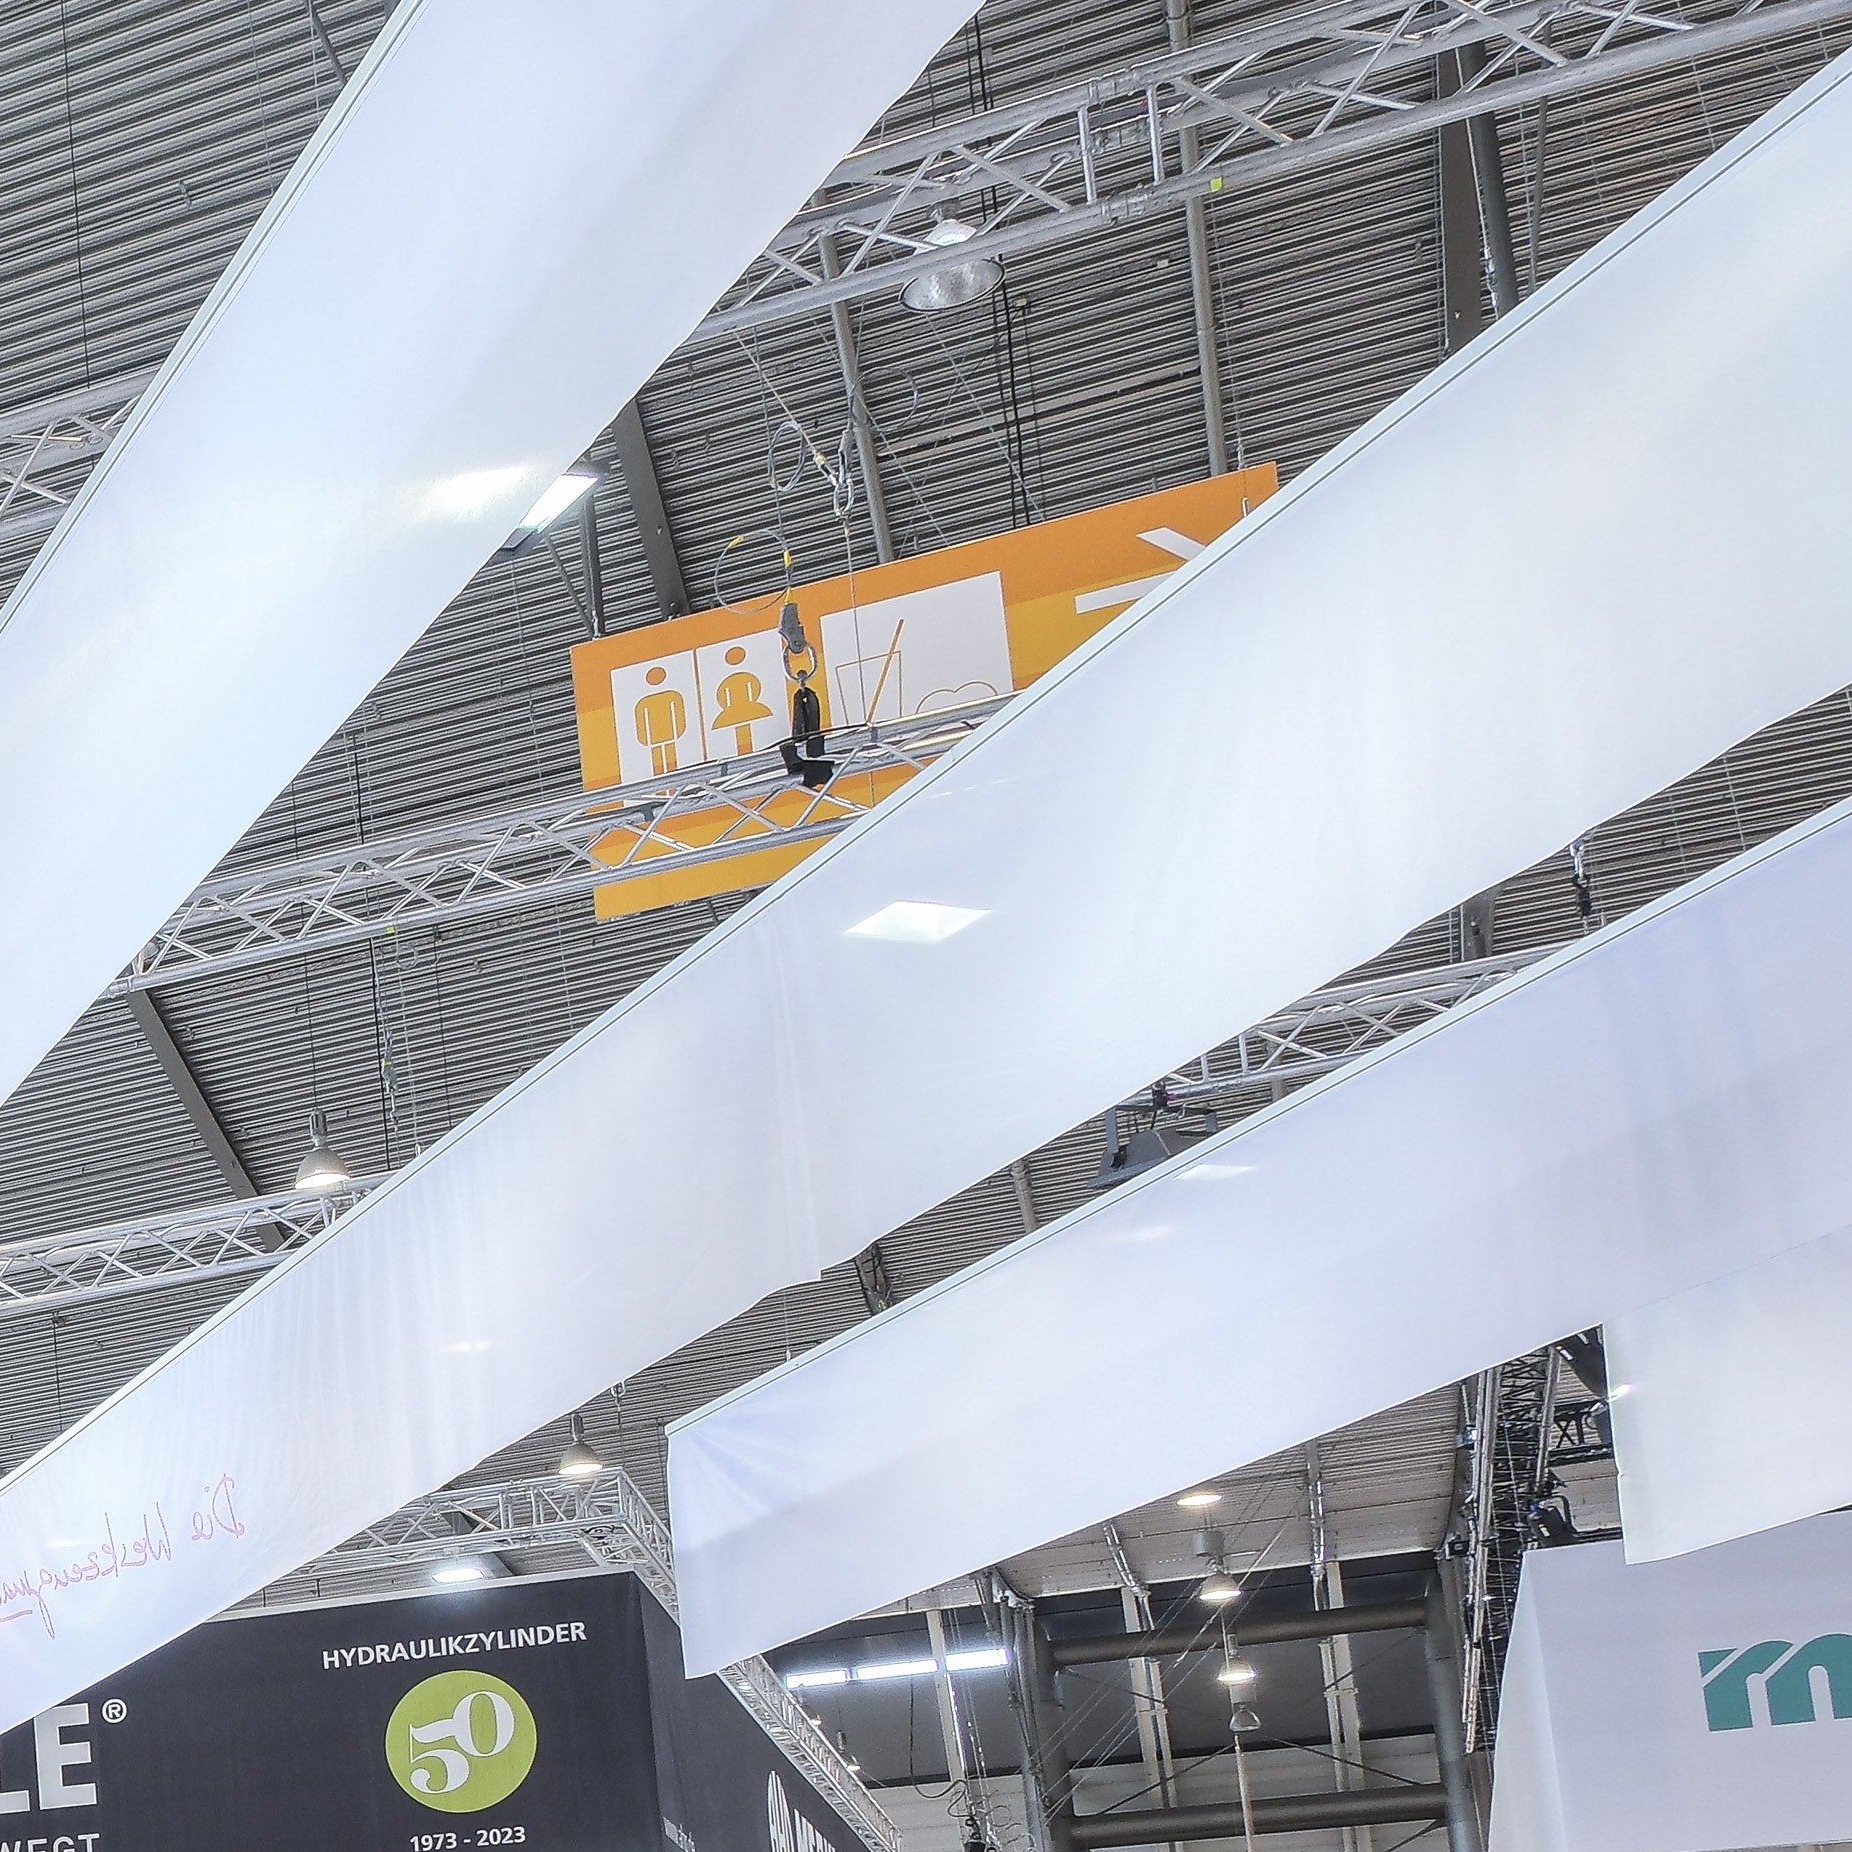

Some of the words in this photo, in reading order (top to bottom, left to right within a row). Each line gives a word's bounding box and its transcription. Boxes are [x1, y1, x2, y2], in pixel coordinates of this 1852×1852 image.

[322, 1621, 587, 1670] HYDRAULIKZYLINDER
[409, 1691, 515, 1794] 50
[409, 1832, 457, 1852] 1973
[476, 1826, 526, 1847] 2023
